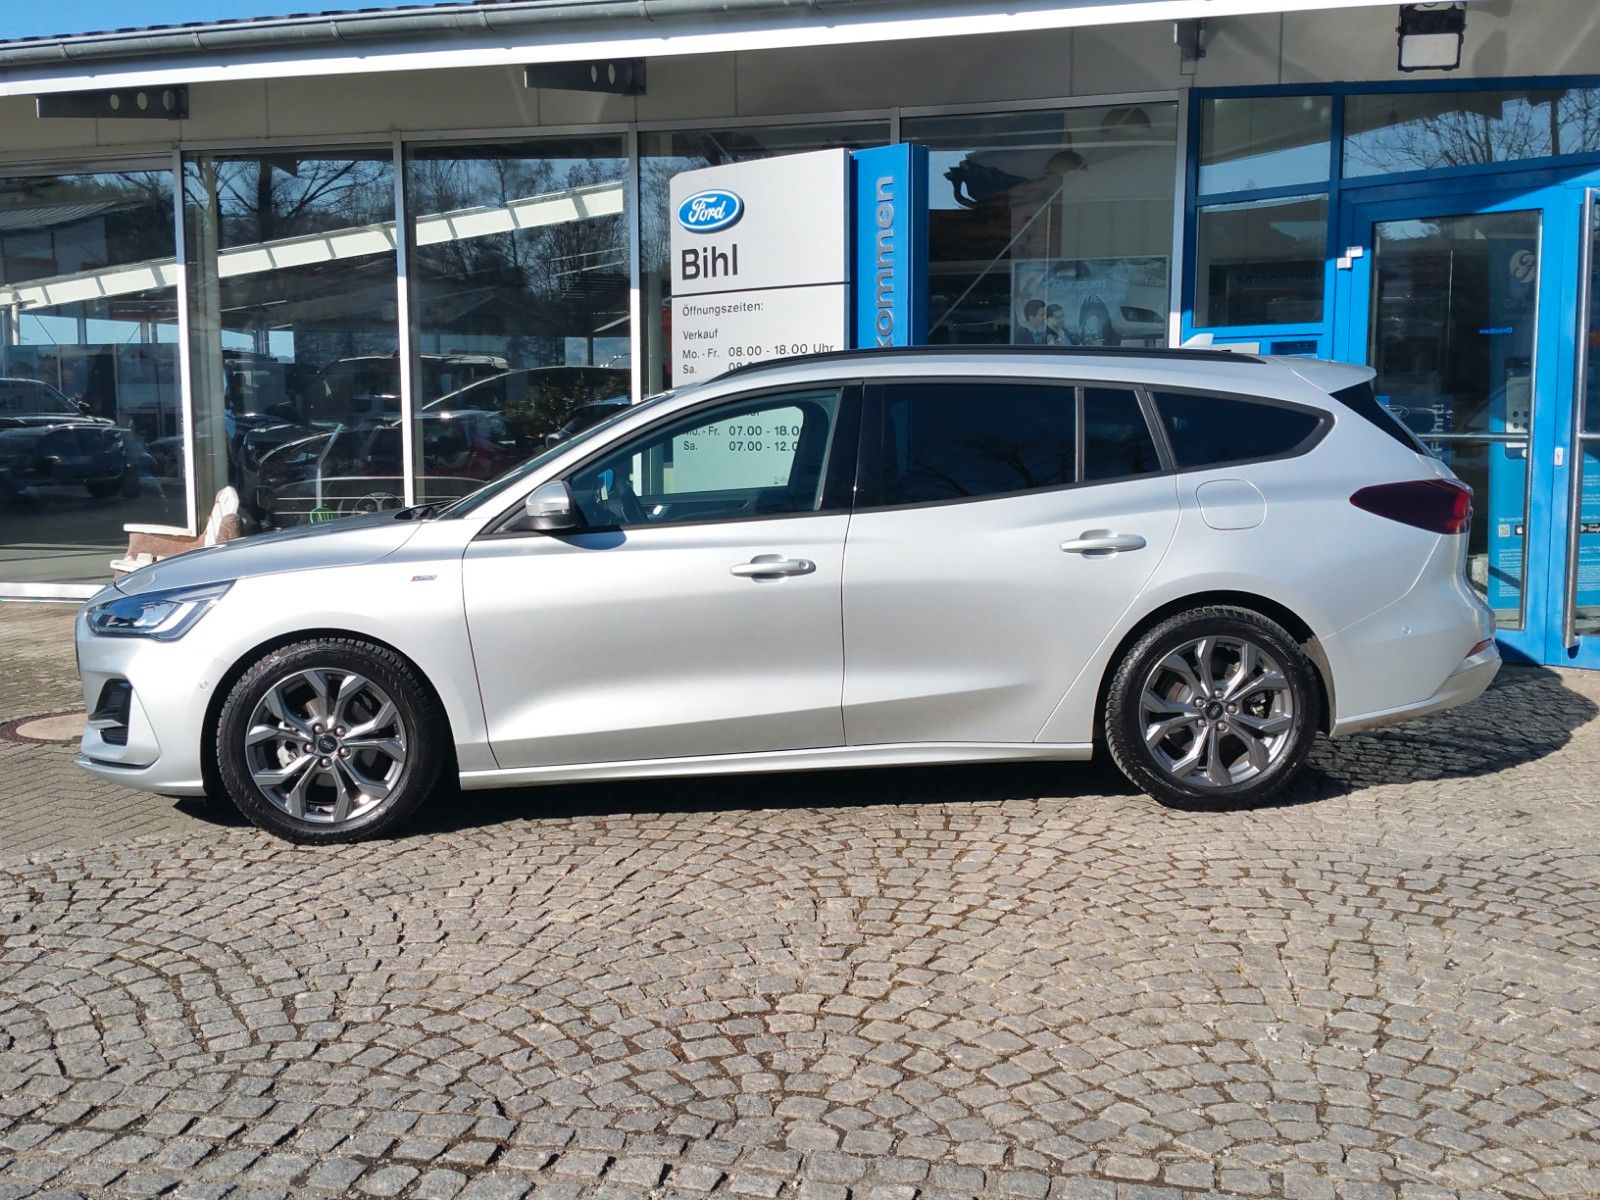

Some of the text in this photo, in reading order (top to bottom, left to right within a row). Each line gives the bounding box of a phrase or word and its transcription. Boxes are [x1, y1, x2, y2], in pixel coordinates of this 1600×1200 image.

[688, 197, 726, 222] Ford
[681, 244, 738, 280] Bihl
[682, 302, 764, 316] Öffnungszeiten:
[683, 328, 718, 340] Verkauf
[728, 345, 762, 357] 08.00
[774, 343, 808, 354] 18.00
[813, 343, 834, 353] Uhr
[682, 364, 697, 374] Sa.
[728, 425, 763, 436] 07.00
[683, 440, 698, 451] Sa.
[728, 440, 763, 452] 07.00
